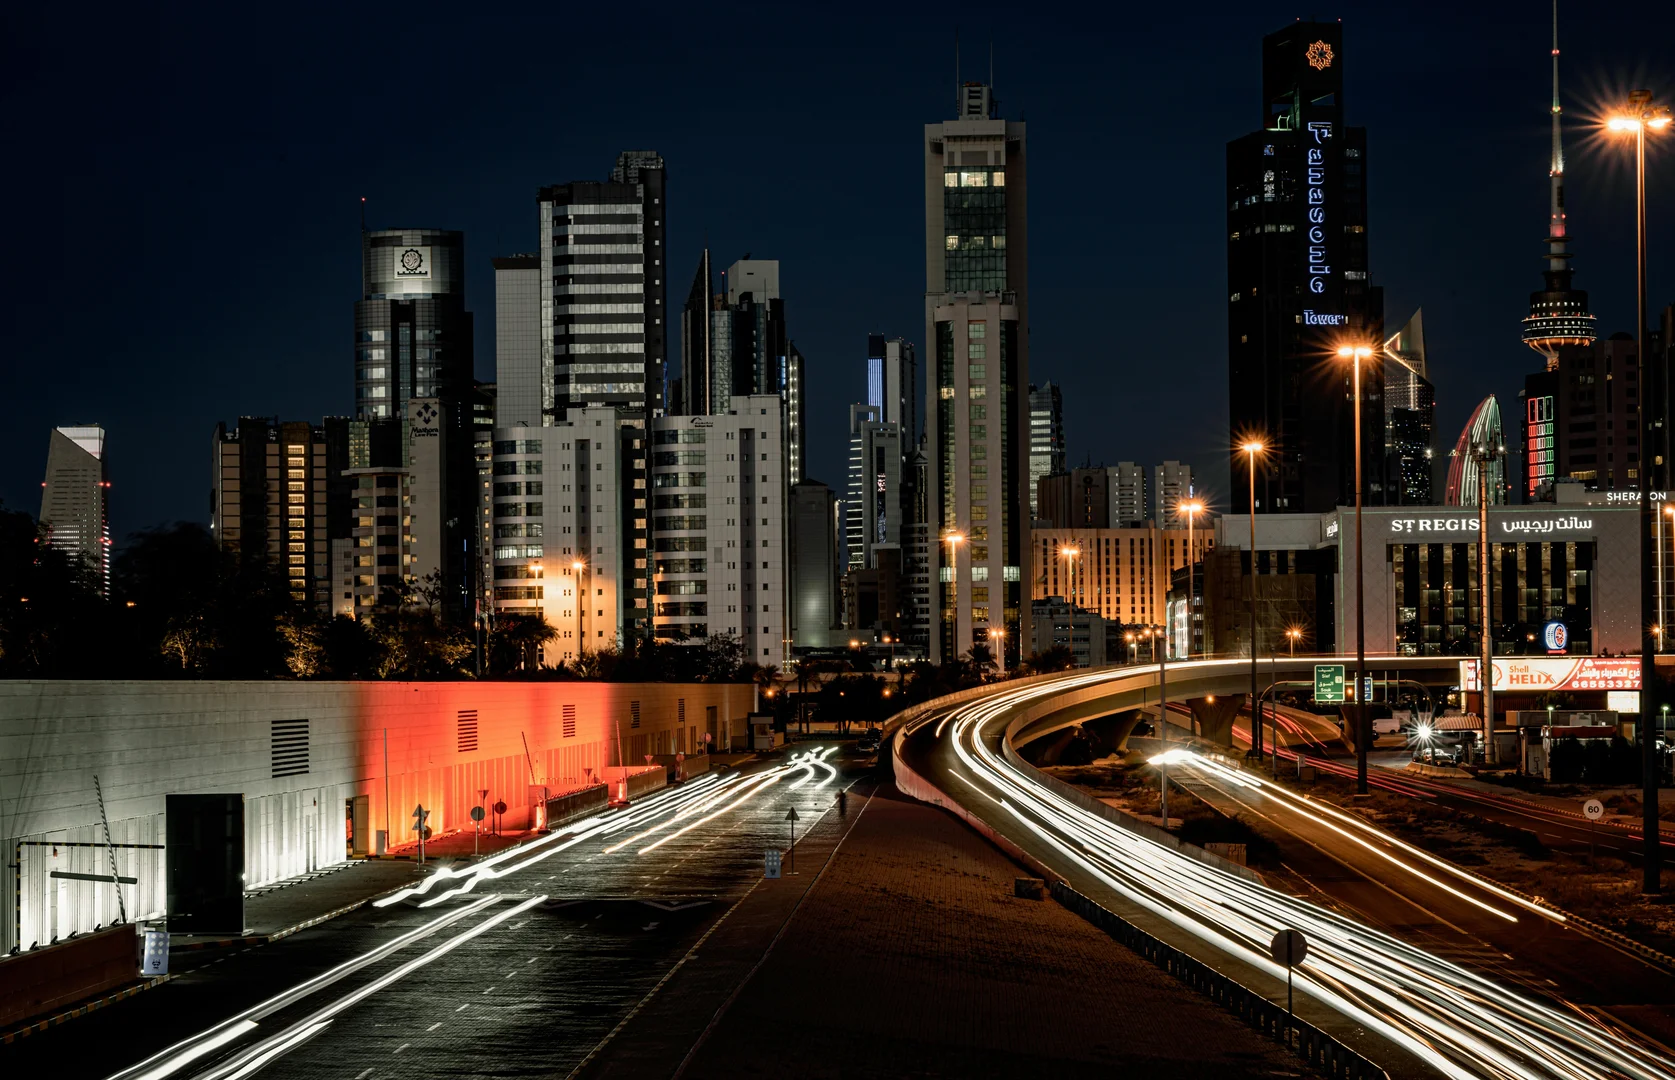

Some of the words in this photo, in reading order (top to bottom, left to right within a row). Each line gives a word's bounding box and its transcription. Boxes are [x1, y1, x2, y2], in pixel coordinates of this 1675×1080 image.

[1307, 121, 1332, 294] Panasonic
[1303, 309, 1344, 325] Tower
[1606, 492, 1667, 501] SHERAON
[1418, 518, 1480, 531] REGIS
[1502, 520, 1553, 533] ريجيس
[1555, 516, 1592, 529] سانت
[1509, 665, 1529, 673] Shell
[1509, 674, 1555, 685] HELIX
[1571, 680, 1641, 688] 66553327
[1587, 805, 1600, 813] 60
